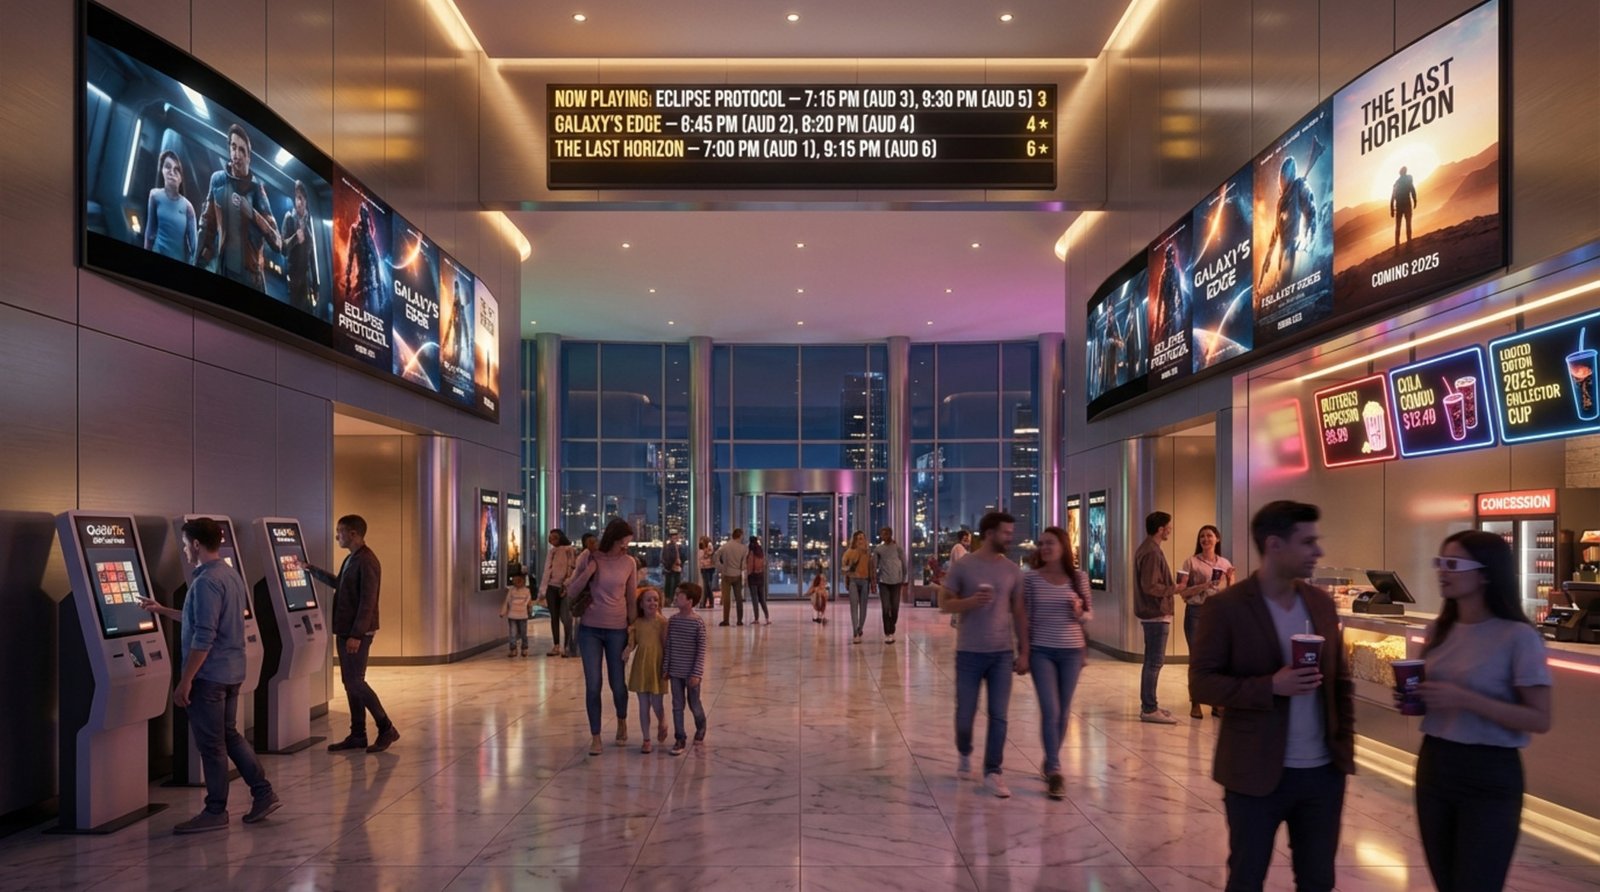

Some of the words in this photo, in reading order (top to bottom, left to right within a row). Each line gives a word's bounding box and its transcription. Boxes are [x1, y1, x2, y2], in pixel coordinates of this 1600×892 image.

[555, 89, 588, 108] NOW
[656, 89, 712, 108] ECLIPSE
[715, 89, 786, 108] PROTOCOL
[839, 89, 860, 108] PM
[864, 89, 897, 109] (AUD
[957, 89, 978, 108] PM
[982, 89, 1015, 109] (AUD
[1018, 89, 1033, 109] 5)
[1037, 90, 1047, 108] 3
[1361, 87, 1395, 127] THE
[1401, 56, 1454, 106] LAST
[555, 114, 623, 133] GALAXY'S
[627, 114, 662, 133] EDGE
[717, 114, 738, 133] PM
[743, 114, 776, 134] (AUD
[838, 114, 859, 133] PM
[863, 114, 897, 134] (AUD
[900, 114, 915, 134] 4)
[1361, 85, 1454, 156] HORIZON
[555, 139, 583, 158] THE
[586, 139, 621, 158] LAST
[624, 139, 684, 158] HORIZON
[703, 139, 735, 158] 7:00
[739, 139, 760, 158] PM
[764, 139, 798, 159] (AUD
[860, 139, 881, 158] PM
[885, 139, 919, 159] (AUD
[922, 139, 937, 159] 6)
[1371, 262, 1409, 288] COMING
[1411, 252, 1440, 275] 2025
[1508, 405, 1532, 425] CUP
